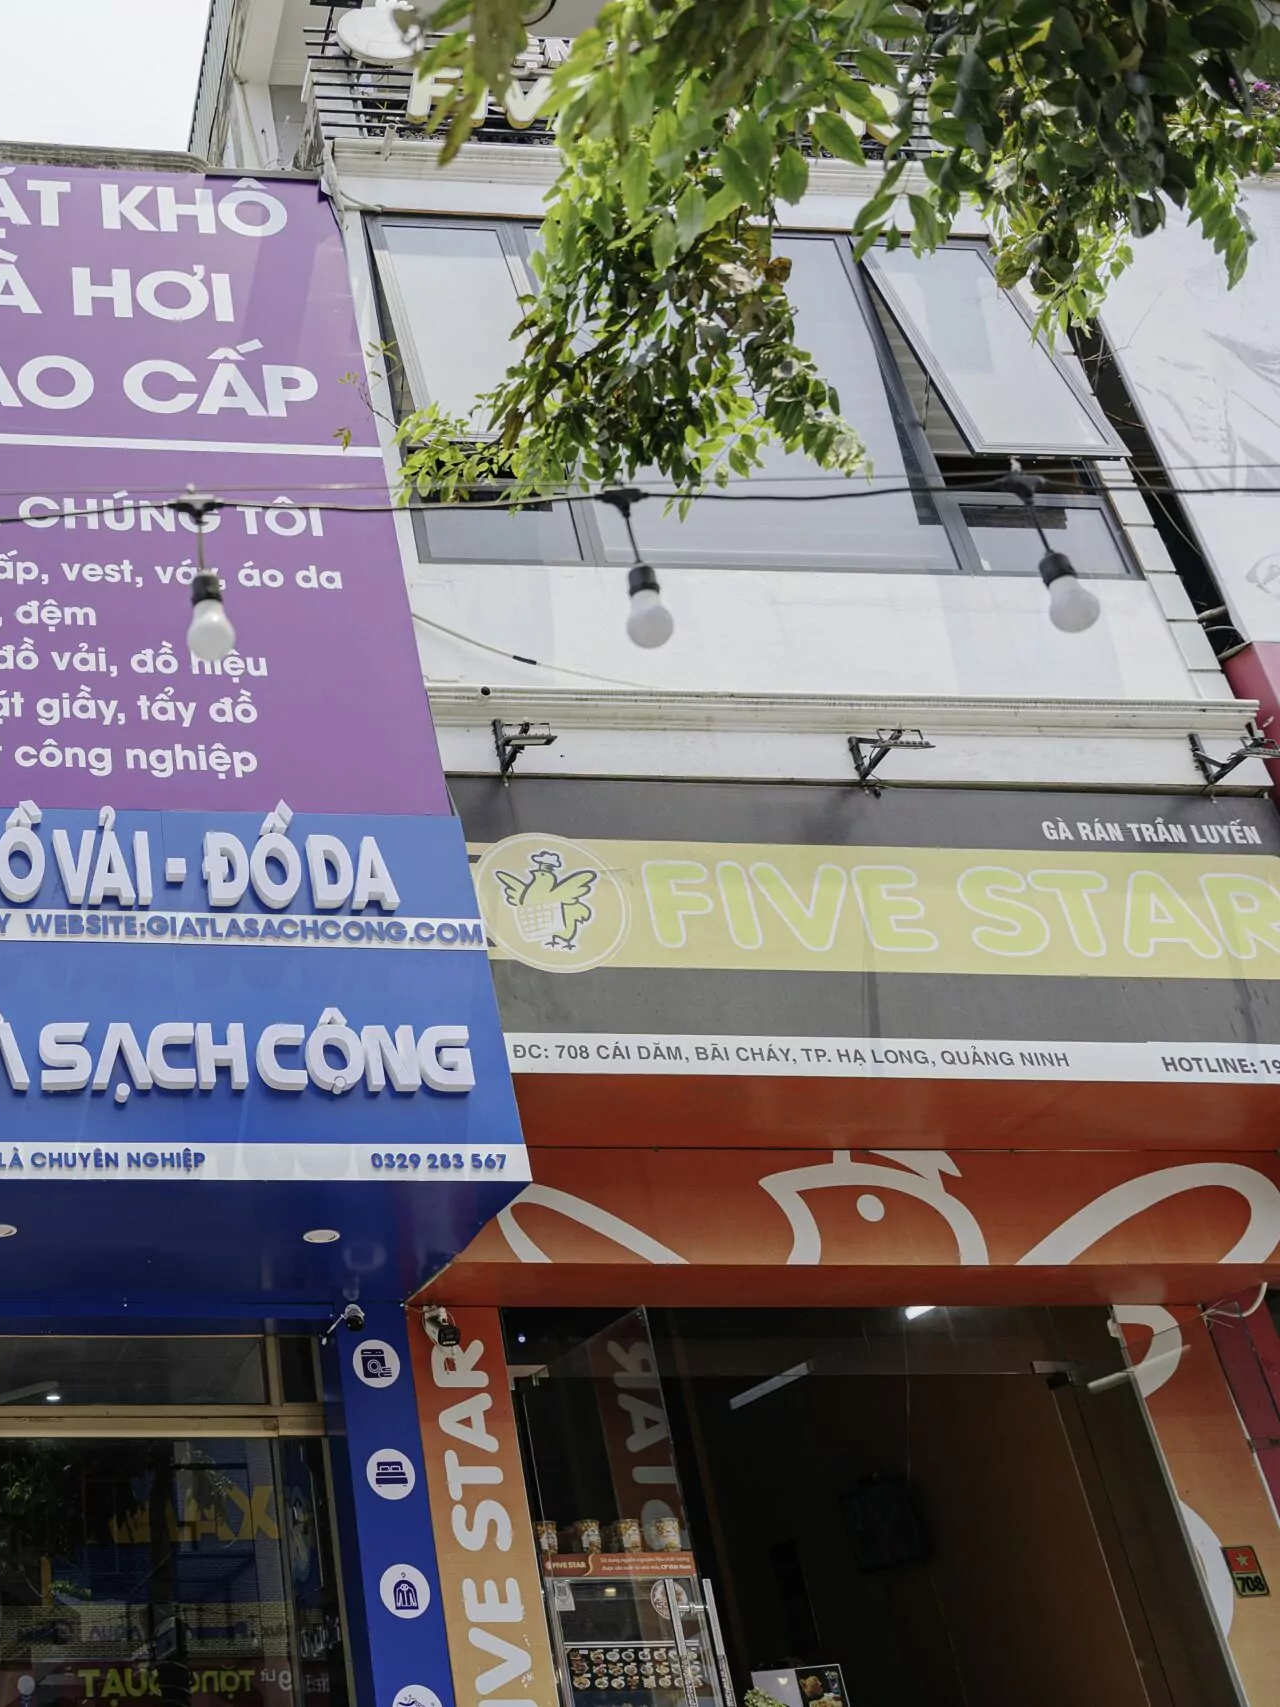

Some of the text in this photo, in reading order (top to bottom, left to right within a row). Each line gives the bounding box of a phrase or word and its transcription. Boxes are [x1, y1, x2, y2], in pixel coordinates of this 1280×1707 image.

[101, 177, 288, 238] KHÔ
[72, 262, 235, 322] HƠI
[123, 339, 318, 417] CẤP
[236, 496, 324, 537] TÔI
[61, 559, 143, 588] vest,
[154, 559, 226, 590] vá,
[237, 561, 284, 588] áo
[295, 565, 343, 590] da
[15, 598, 97, 632] đệm
[51, 642, 118, 677] vải,
[131, 640, 179, 675] đồ
[35, 683, 125, 728] giầy,
[136, 686, 196, 728] tẩy
[209, 689, 257, 725] đồ
[14, 739, 113, 777] công
[126, 741, 258, 778] nghiệp
[1041, 816, 1262, 845] GÀ RÁN TRẦN LUYẾN
[52, 805, 153, 906] VẢI
[305, 834, 401, 911] DA
[641, 859, 1280, 960] FIVE STAR
[39, 1022, 249, 1104] SẠCH
[256, 1006, 476, 1094] CỘNG
[512, 1041, 1070, 1068] ĐC: 708 CÁI DĂM, BÃI CHÁY, TP. HẠ LONG, QUẢNG NINH
[1161, 1056, 1258, 1074] HOTLINE:
[30, 1148, 119, 1170] CHUYÊN
[126, 1148, 206, 1174] NGHIỆP
[371, 1152, 421, 1170] 0329
[427, 1152, 465, 1170] 283
[471, 1152, 507, 1170] 567
[431, 1339, 514, 1552] STAR
[1237, 1576, 1266, 1593] 708
